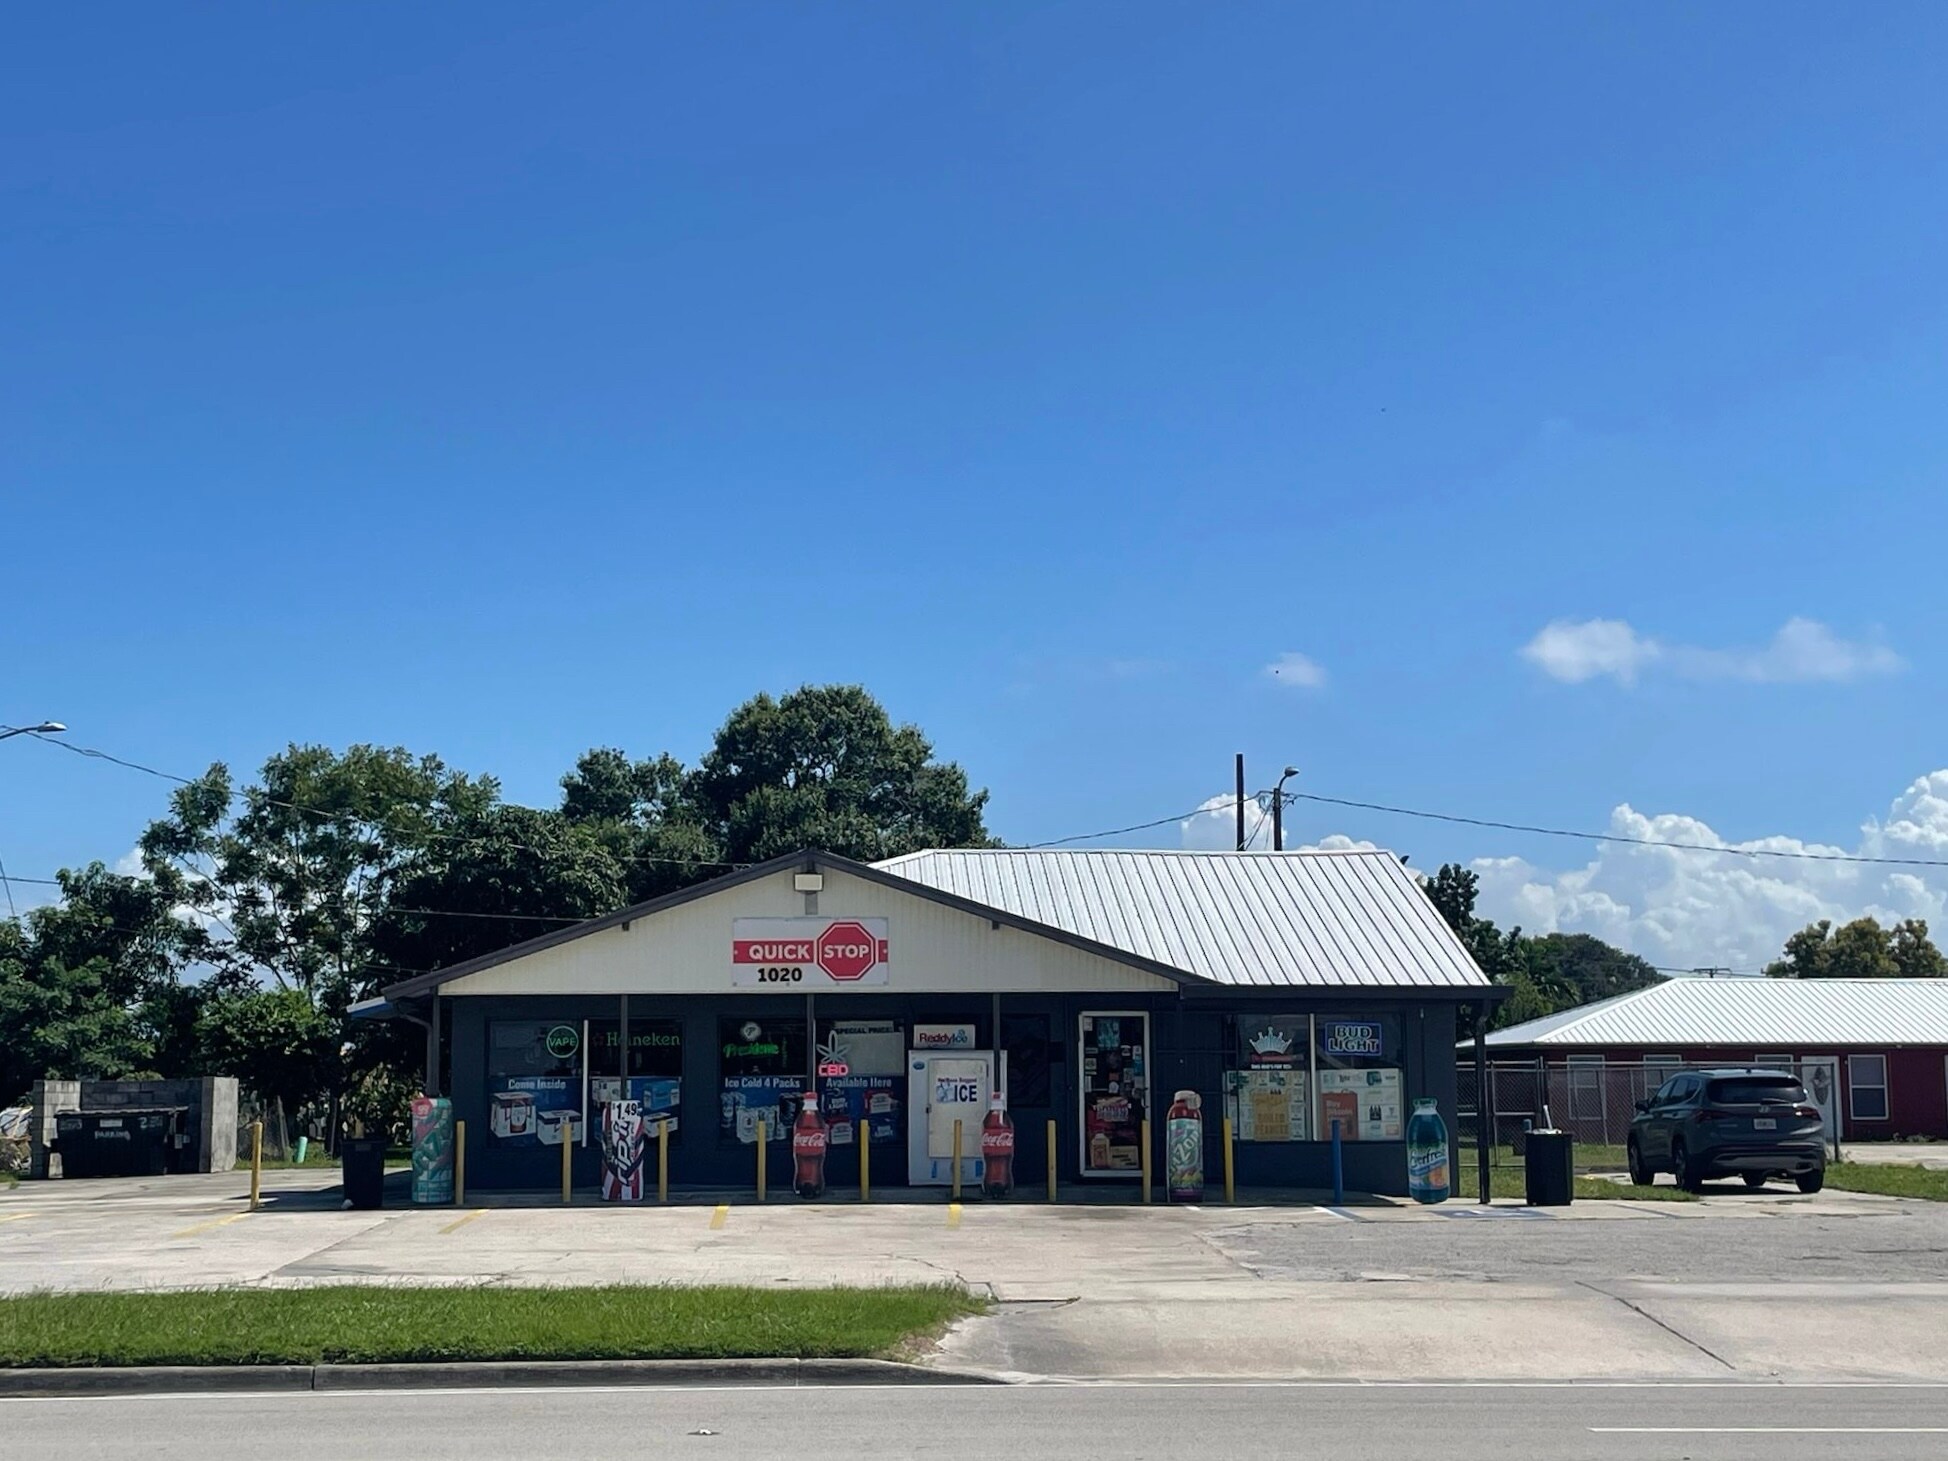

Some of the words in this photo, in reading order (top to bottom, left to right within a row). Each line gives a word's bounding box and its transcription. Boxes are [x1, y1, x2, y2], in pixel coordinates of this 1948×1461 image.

[749, 944, 810, 960] QUICK
[823, 944, 870, 958] STOP
[757, 967, 803, 982] 1020
[1334, 1025, 1373, 1039] BUD
[549, 1037, 576, 1047] VAPE
[606, 1032, 681, 1047] Hineken
[1327, 1037, 1380, 1053] LIGHT
[818, 1064, 849, 1077] CBD
[508, 1079, 536, 1090] Come
[537, 1079, 567, 1090] Inside
[724, 1078, 740, 1089] Ice
[741, 1078, 763, 1089] Cold
[763, 1078, 771, 1088] 4
[772, 1078, 801, 1089] Packs
[826, 1078, 868, 1088] Available
[870, 1078, 892, 1088] Here
[953, 1084, 978, 1102] ICE
